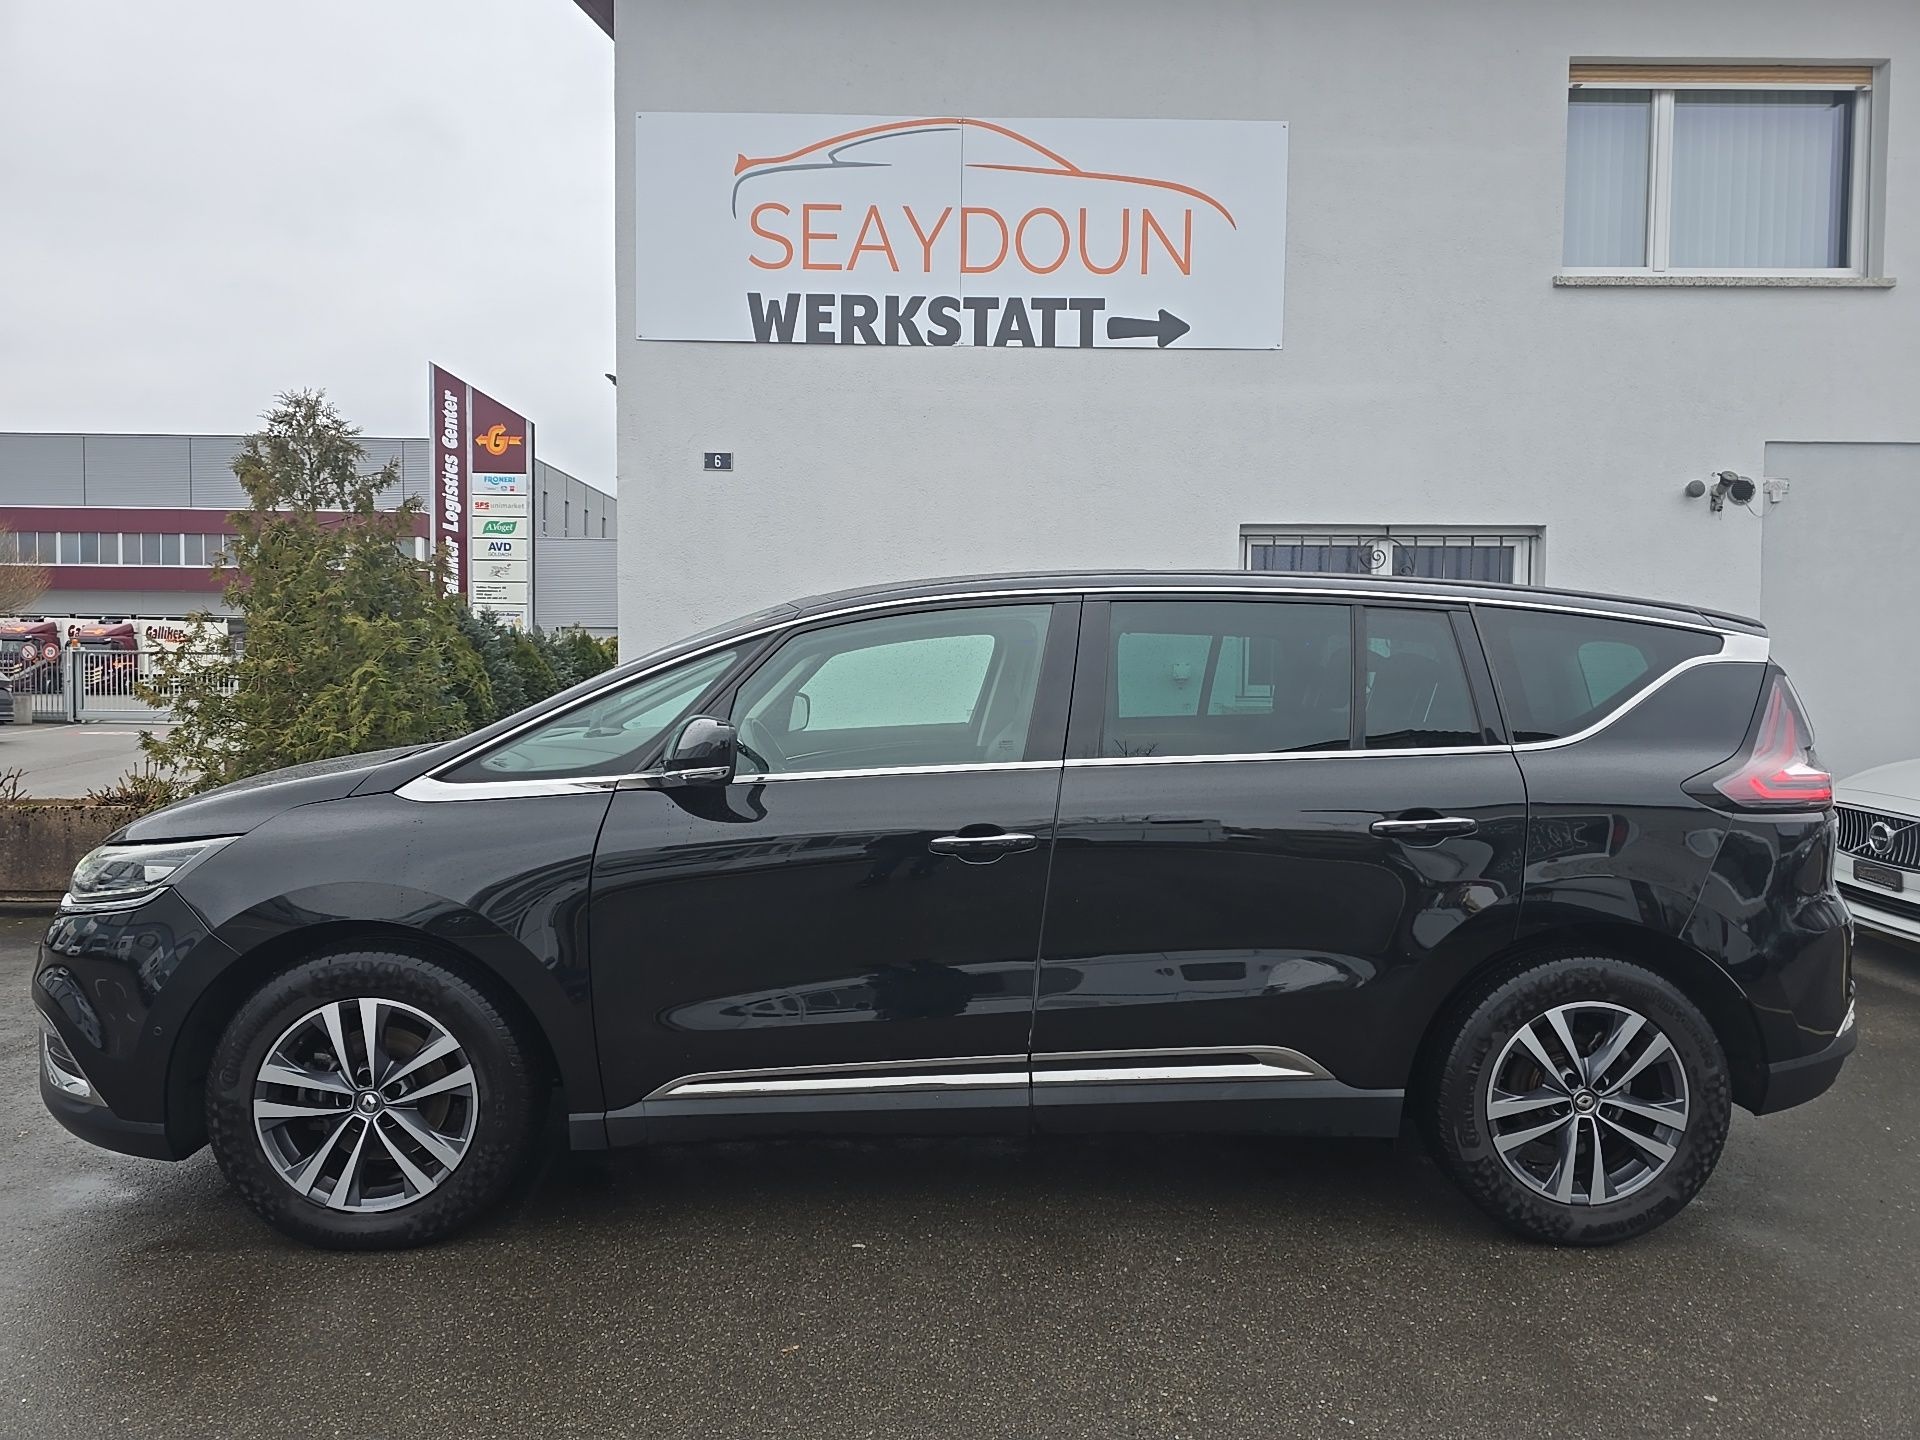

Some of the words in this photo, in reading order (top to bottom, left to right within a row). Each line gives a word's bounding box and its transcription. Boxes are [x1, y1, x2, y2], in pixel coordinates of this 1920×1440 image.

[748, 202, 1192, 276] SEAYDOUN
[747, 292, 1106, 347] WERKSTATT
[442, 390, 458, 449] Center
[715, 455, 722, 467] 6
[442, 454, 461, 532] Logistics
[484, 476, 516, 485] FRONERI
[488, 542, 512, 551] AVD
[146, 626, 184, 639] Galliker
